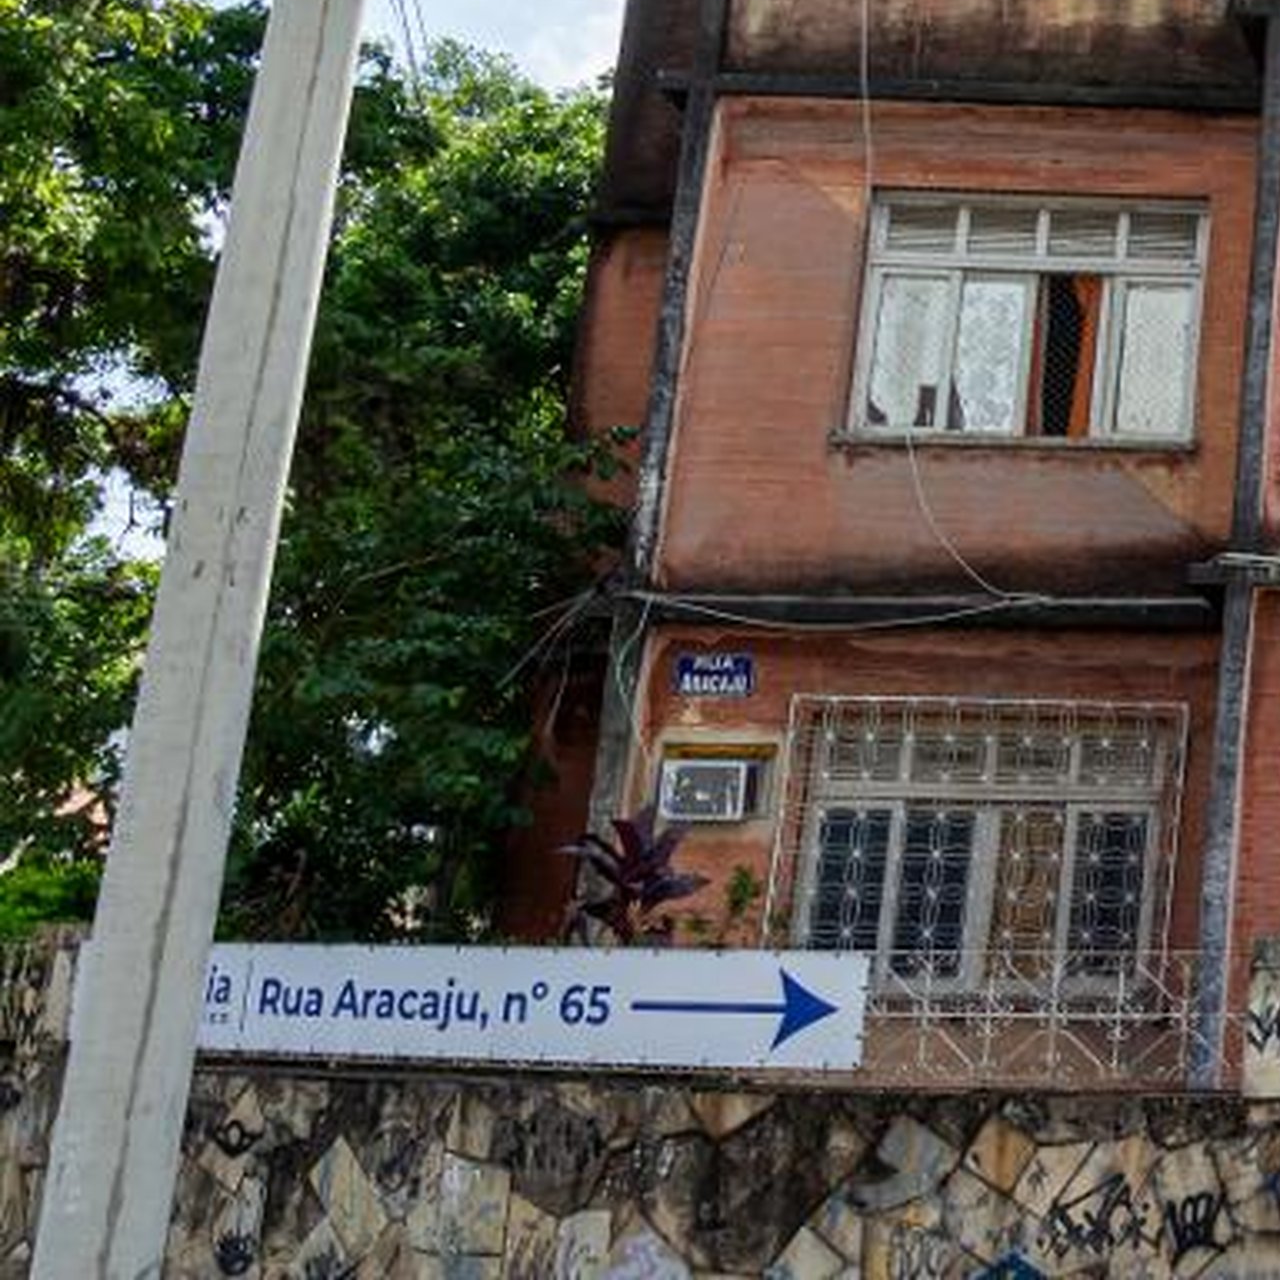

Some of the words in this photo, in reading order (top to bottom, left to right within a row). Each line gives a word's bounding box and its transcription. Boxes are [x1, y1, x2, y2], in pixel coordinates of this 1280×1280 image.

[258, 977, 324, 1017] Rua
[332, 977, 489, 1031] Aracaju,
[559, 984, 611, 1026] 65
